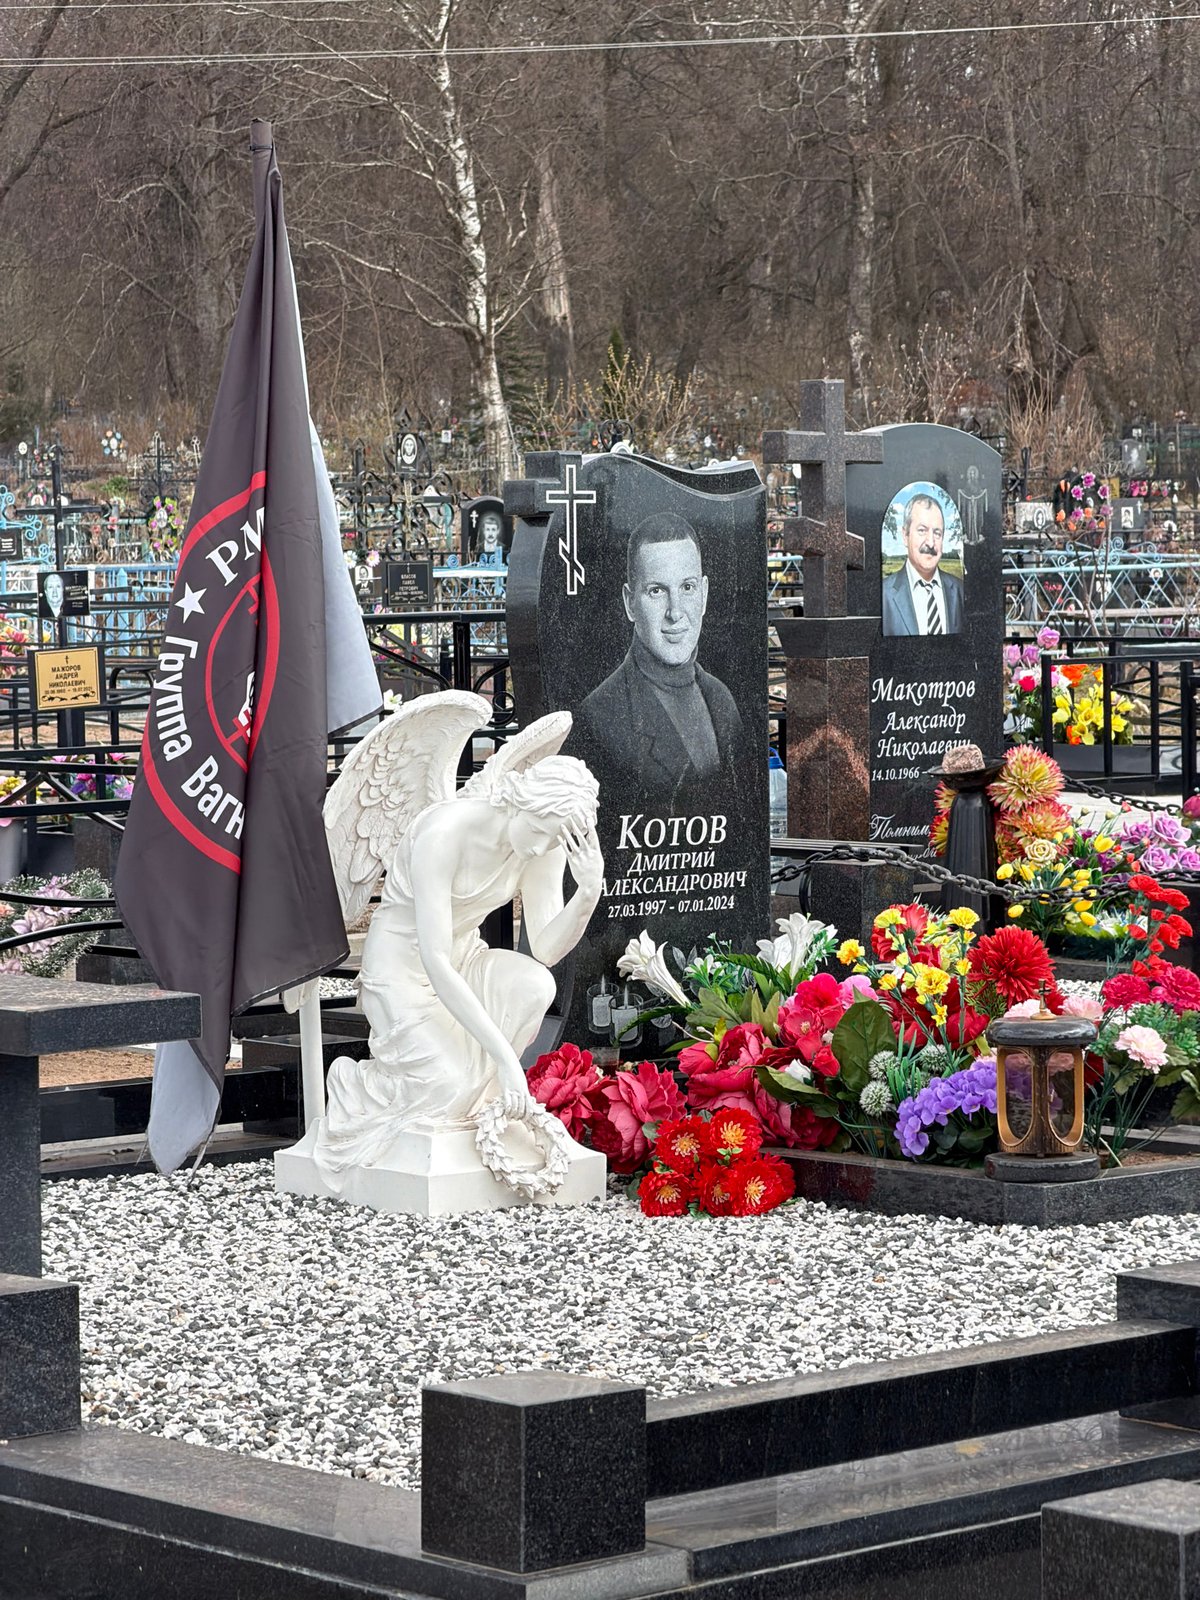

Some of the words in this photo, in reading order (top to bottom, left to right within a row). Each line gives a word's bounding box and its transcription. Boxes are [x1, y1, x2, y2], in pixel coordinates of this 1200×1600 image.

[51, 664, 81, 672] МАЖОРОВ
[55, 672, 78, 680] АНДРЕЙ
[49, 680, 85, 688] НИКОЛАЕВИЧ
[871, 677, 976, 707] Макотров
[153, 636, 199, 762] Группа
[881, 705, 966, 734] Александр
[872, 766, 920, 782] 14.10.1966
[608, 899, 667, 918] 27.03.1997
[677, 894, 735, 913] 07.01.2024
